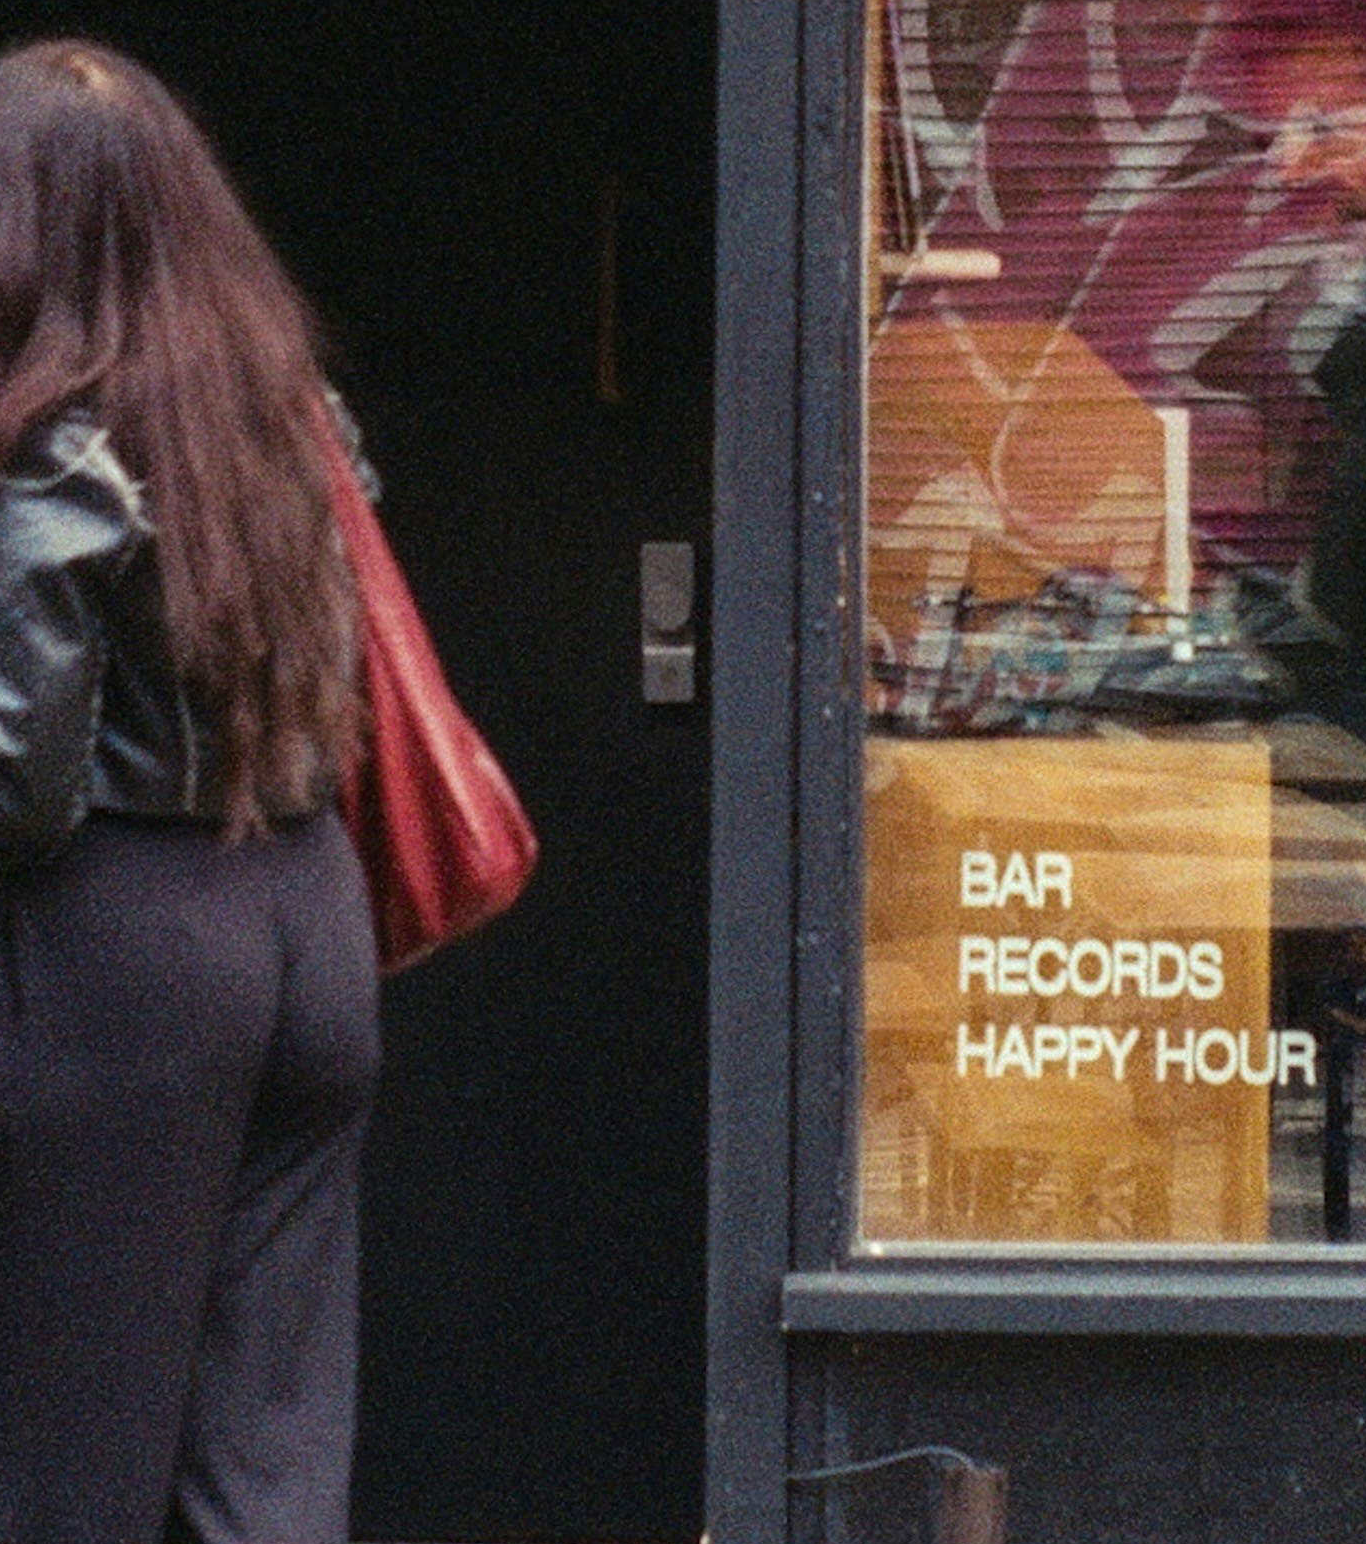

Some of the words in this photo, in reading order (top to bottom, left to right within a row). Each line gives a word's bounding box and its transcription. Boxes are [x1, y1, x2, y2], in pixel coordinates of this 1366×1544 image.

[960, 851, 1074, 909] BAR
[958, 936, 1225, 1000] RECORDS
[956, 1023, 1141, 1081] HAPPY
[1154, 1029, 1317, 1086] HOUR
